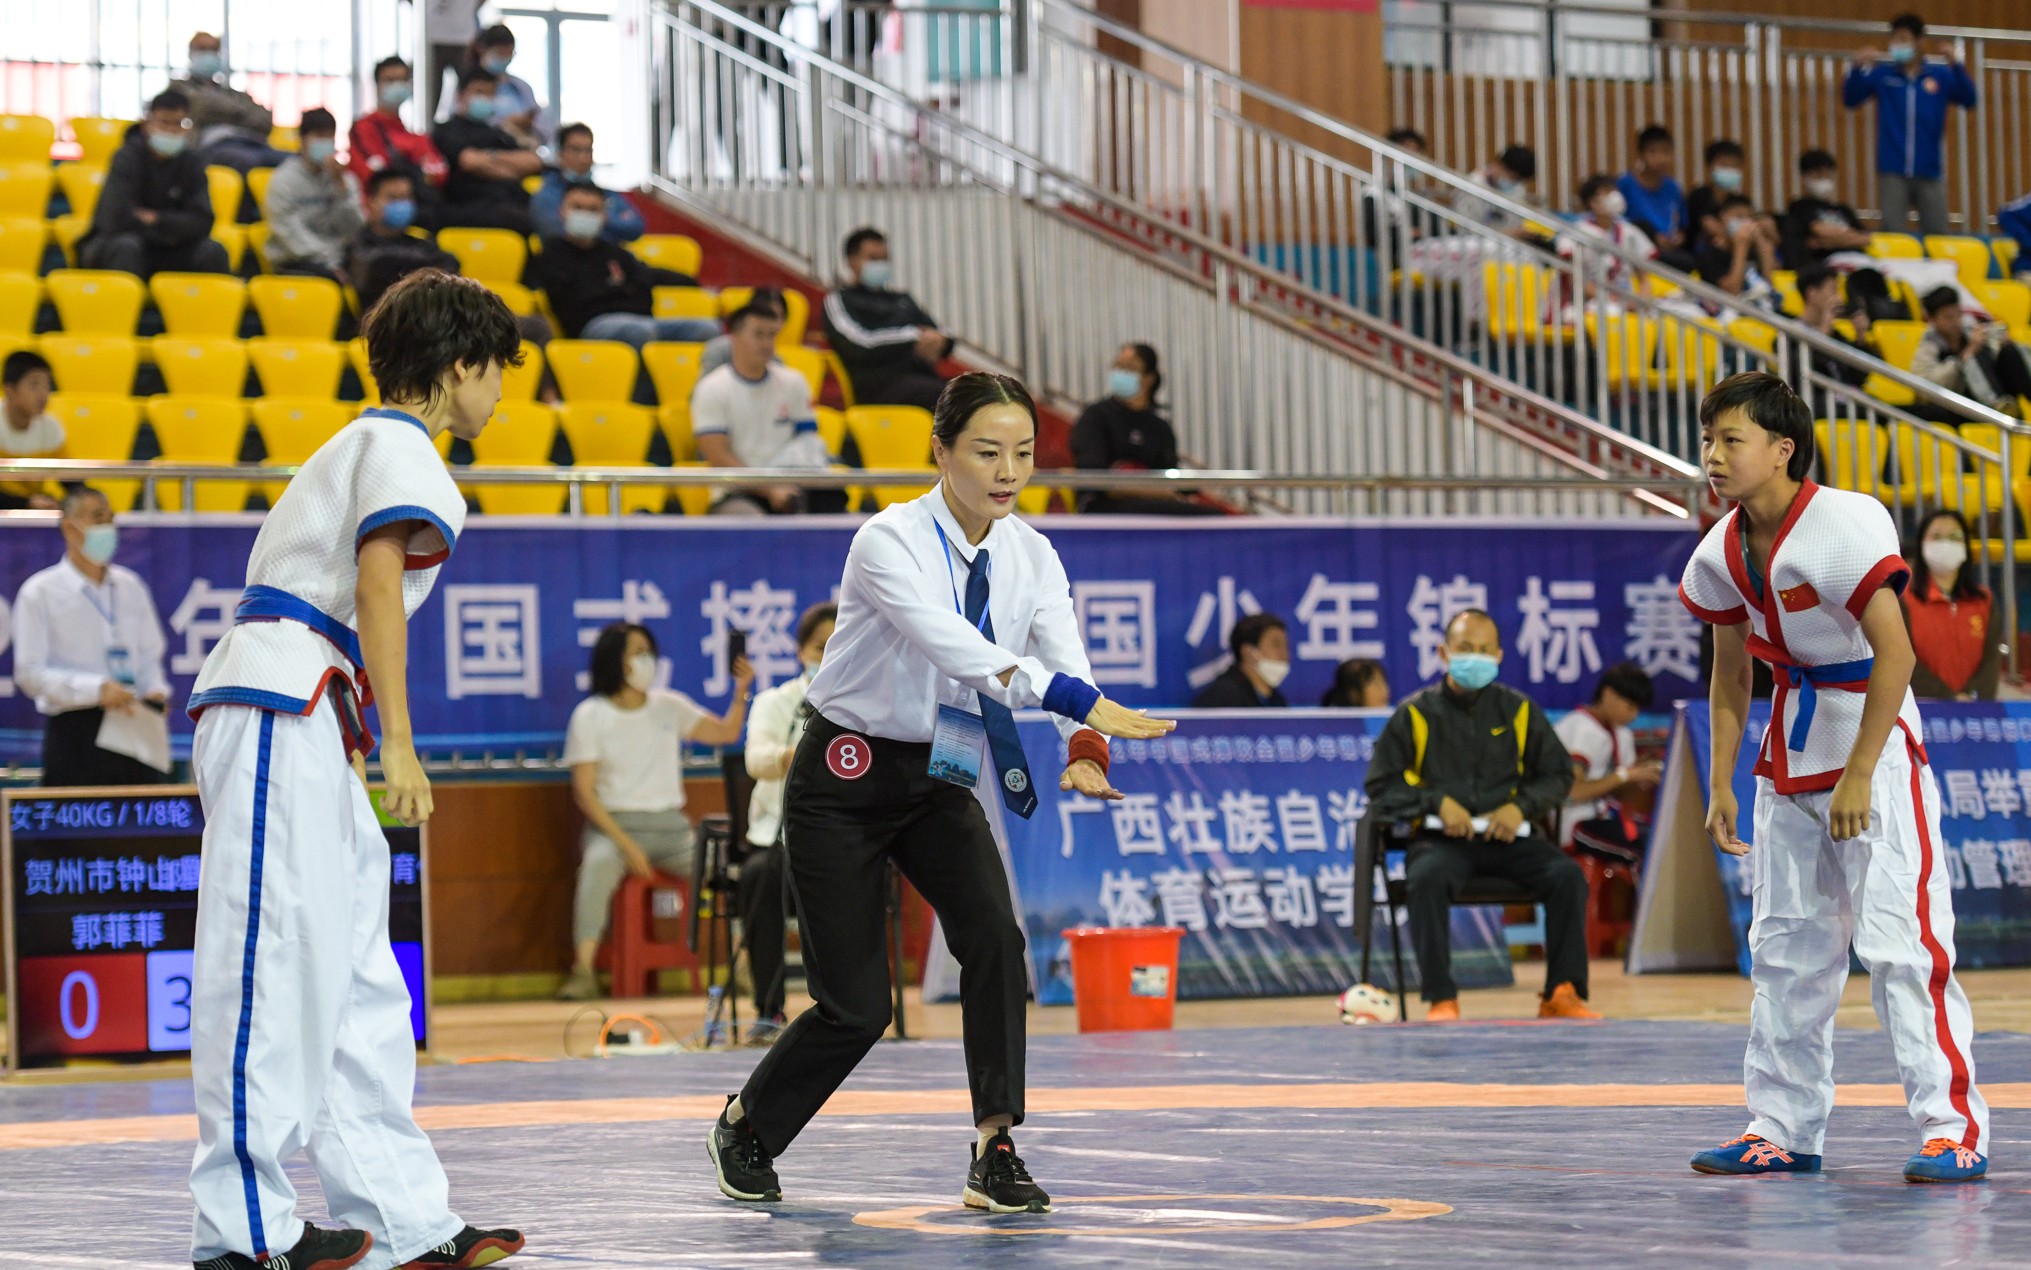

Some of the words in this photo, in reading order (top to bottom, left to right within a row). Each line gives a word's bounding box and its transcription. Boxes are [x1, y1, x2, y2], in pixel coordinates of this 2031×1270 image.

[840, 744, 859, 770] 8
[10, 801, 114, 831] 女子40KG
[59, 969, 100, 1040] 0
[164, 976, 193, 1034] 3
